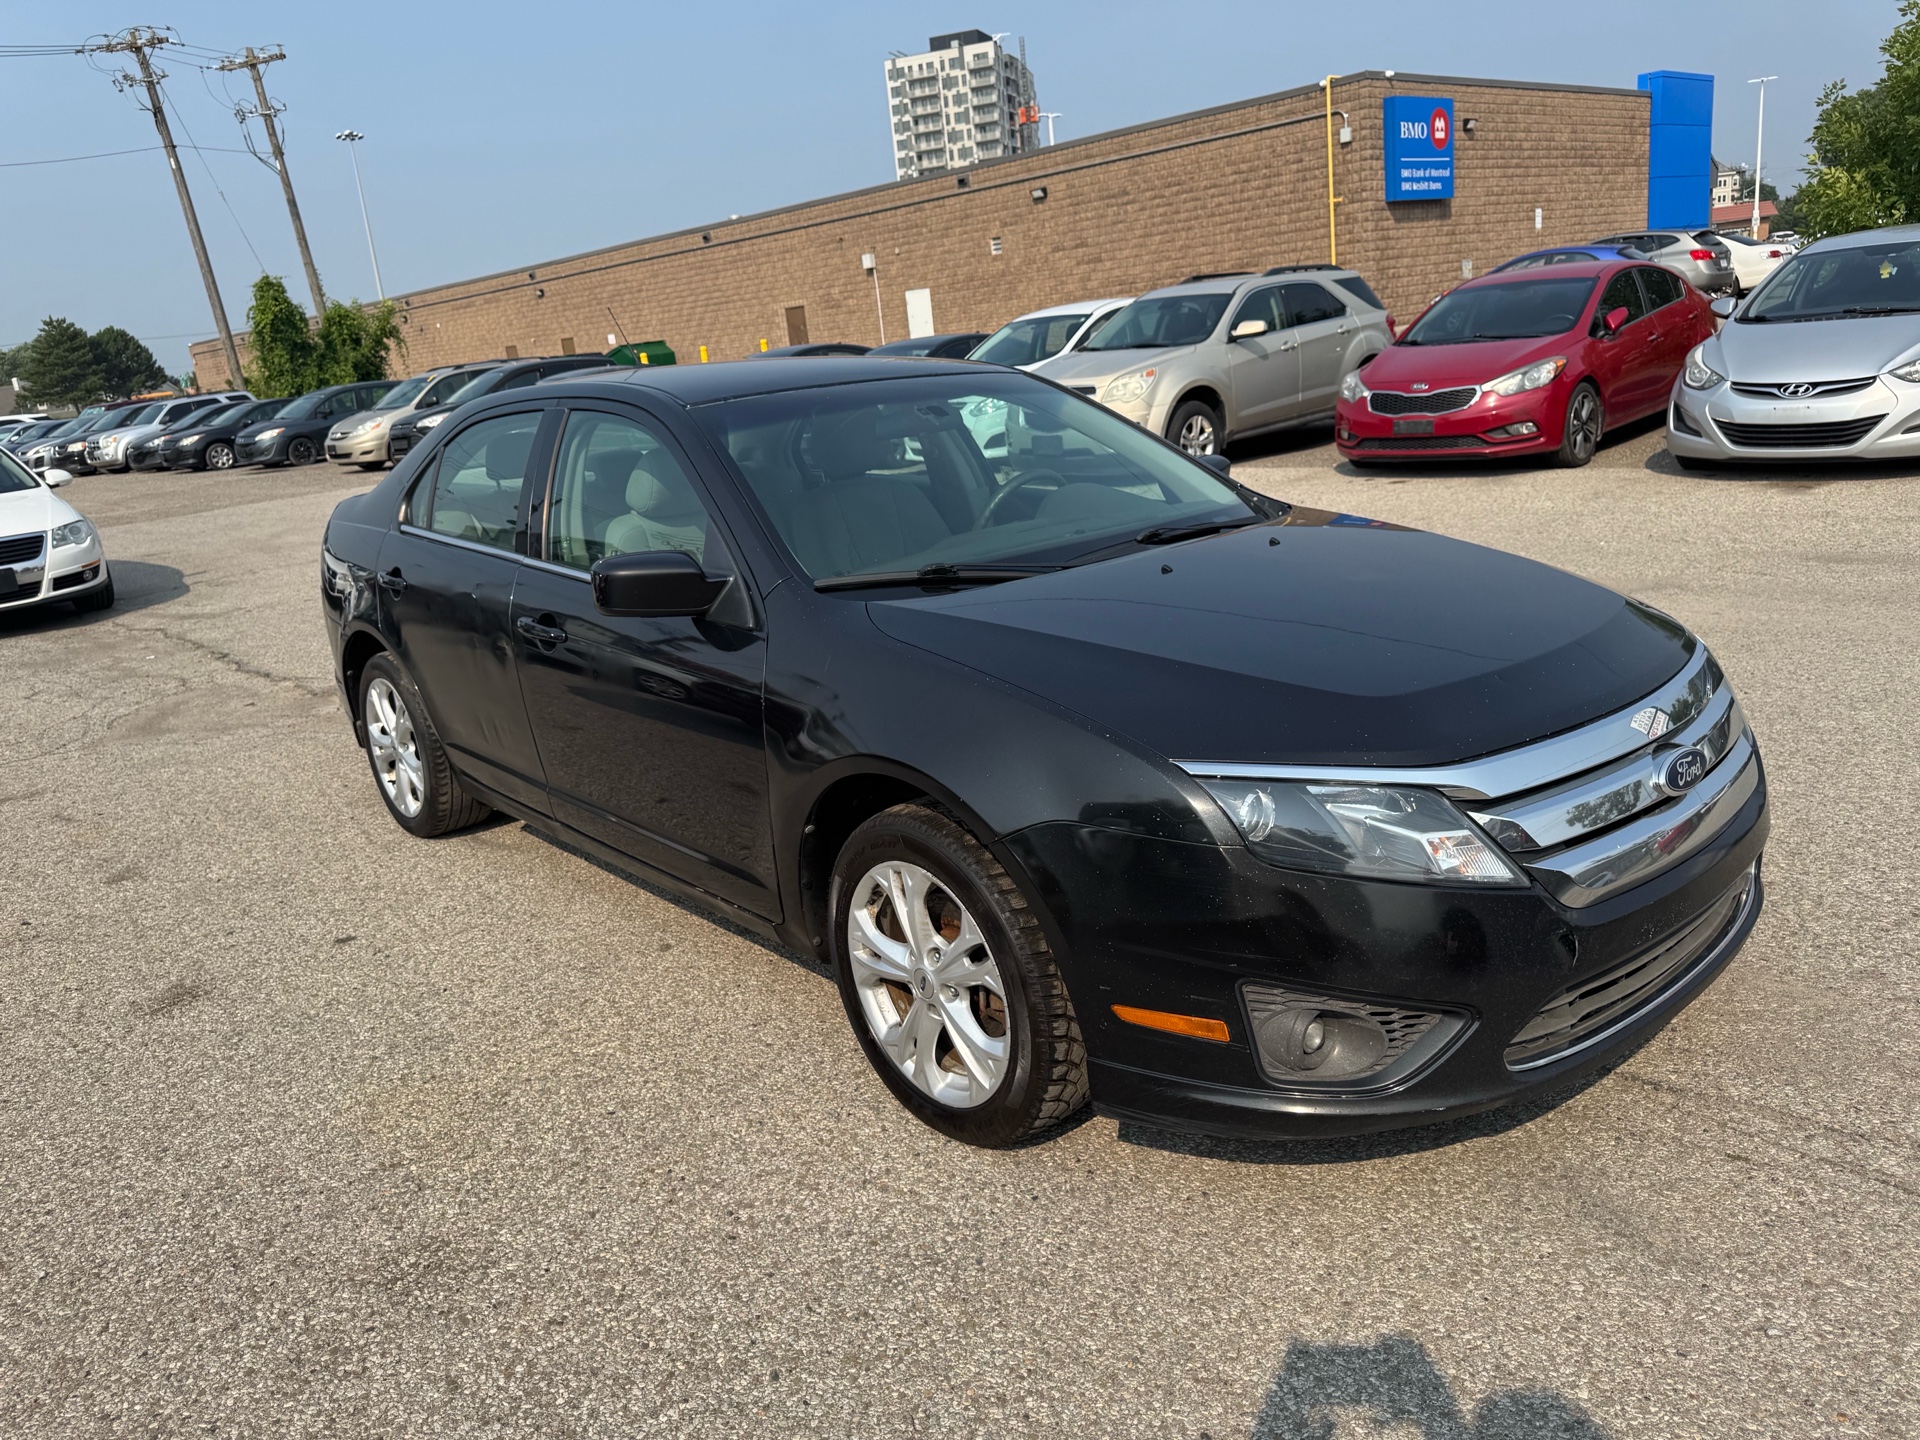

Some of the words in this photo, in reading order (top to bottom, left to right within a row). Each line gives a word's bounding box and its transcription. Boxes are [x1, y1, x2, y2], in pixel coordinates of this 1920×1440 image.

[1400, 122, 1427, 139] BMO
[1413, 168, 1424, 177] Bank
[1425, 168, 1430, 177] of
[1431, 167, 1450, 177] Montreal
[1413, 181, 1428, 190] Nesbitt
[1429, 181, 1442, 190] Burns
[1677, 755, 1702, 786] Ford
